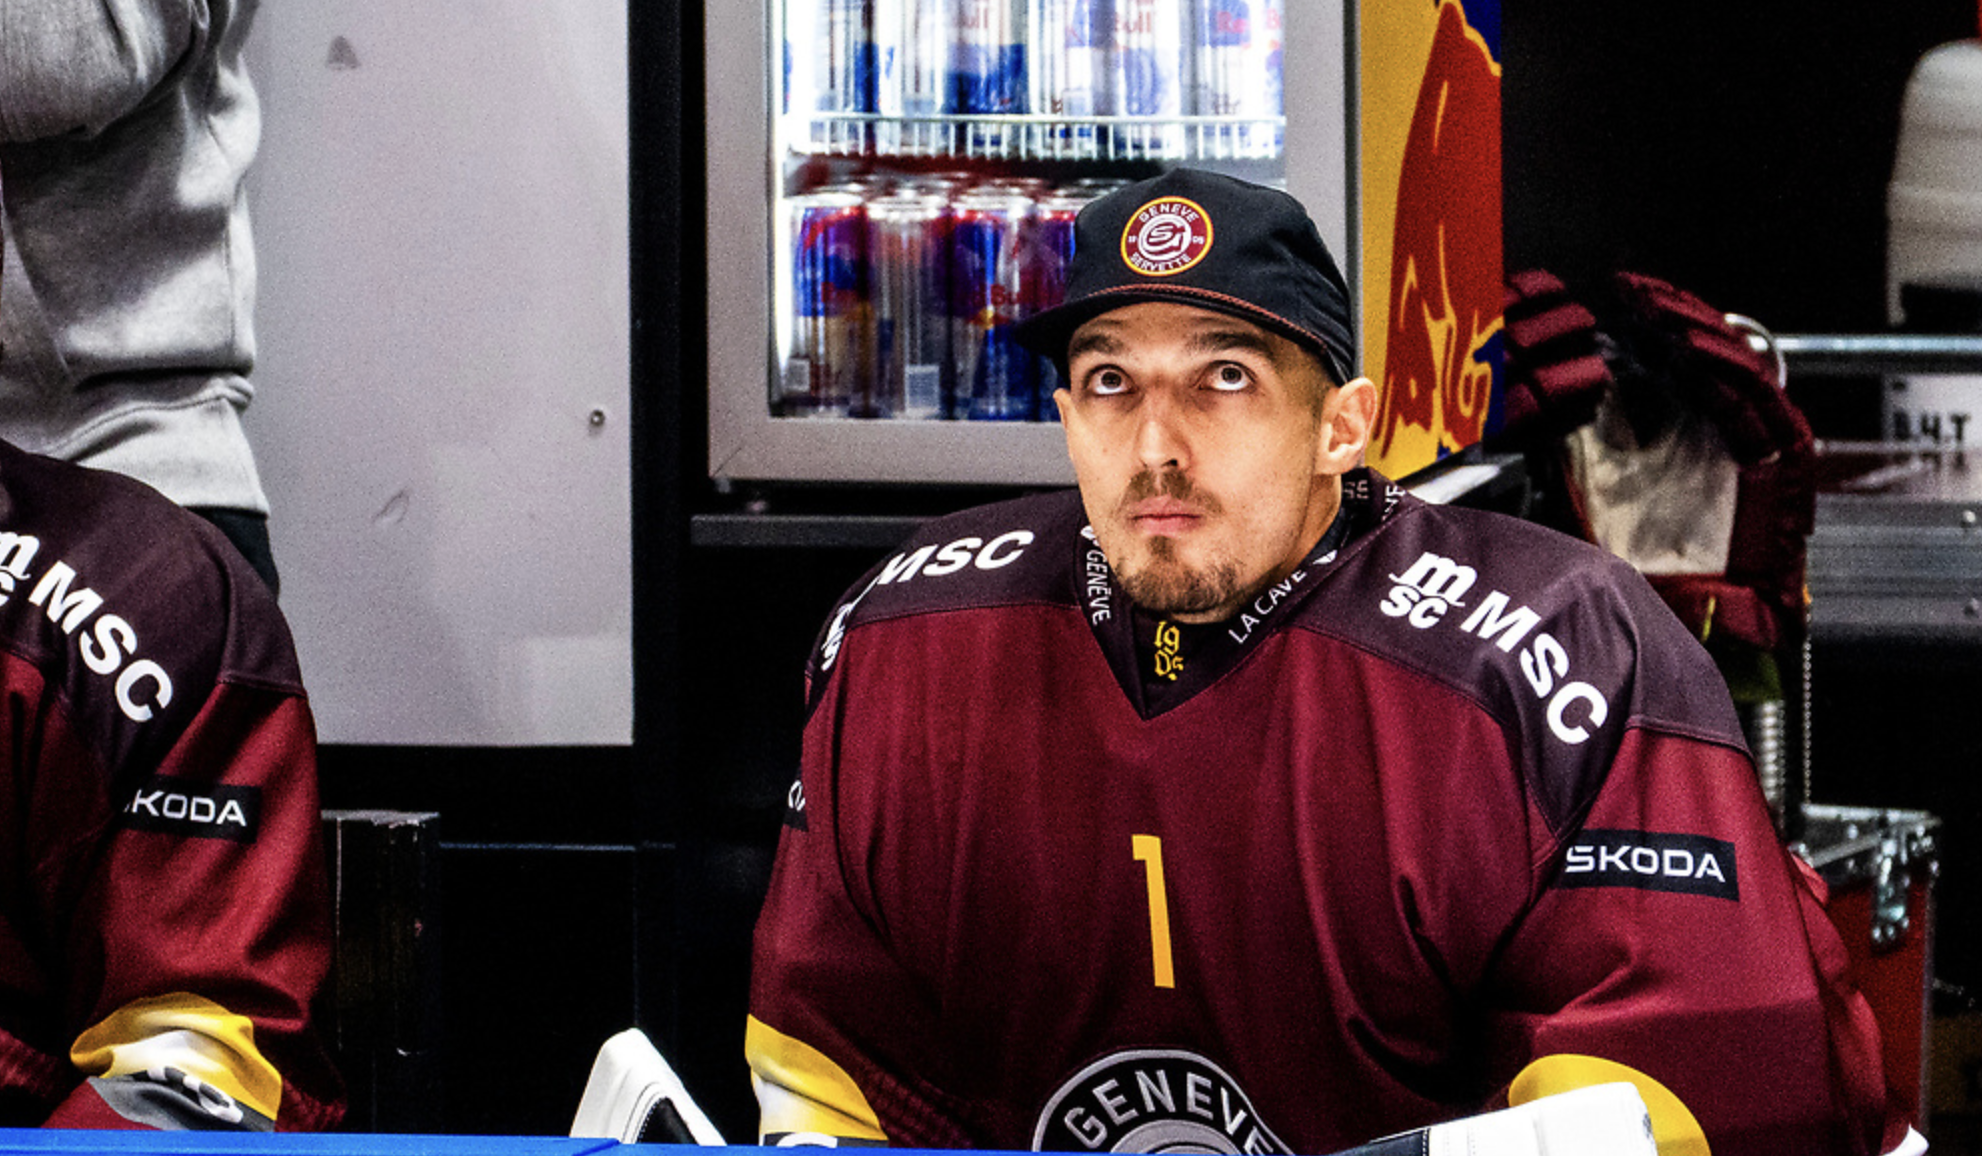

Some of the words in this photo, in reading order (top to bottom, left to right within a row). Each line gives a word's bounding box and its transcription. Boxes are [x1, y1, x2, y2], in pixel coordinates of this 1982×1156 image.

[1139, 203, 1199, 222] GENEVE
[1130, 252, 1192, 271] SERVETTE
[28, 560, 173, 723] MSC
[1228, 613, 1260, 644] LA
[1254, 569, 1308, 616] CAVE
[1459, 590, 1608, 745] MSC
[123, 789, 247, 827] KODA
[1131, 833, 1175, 989] 1
